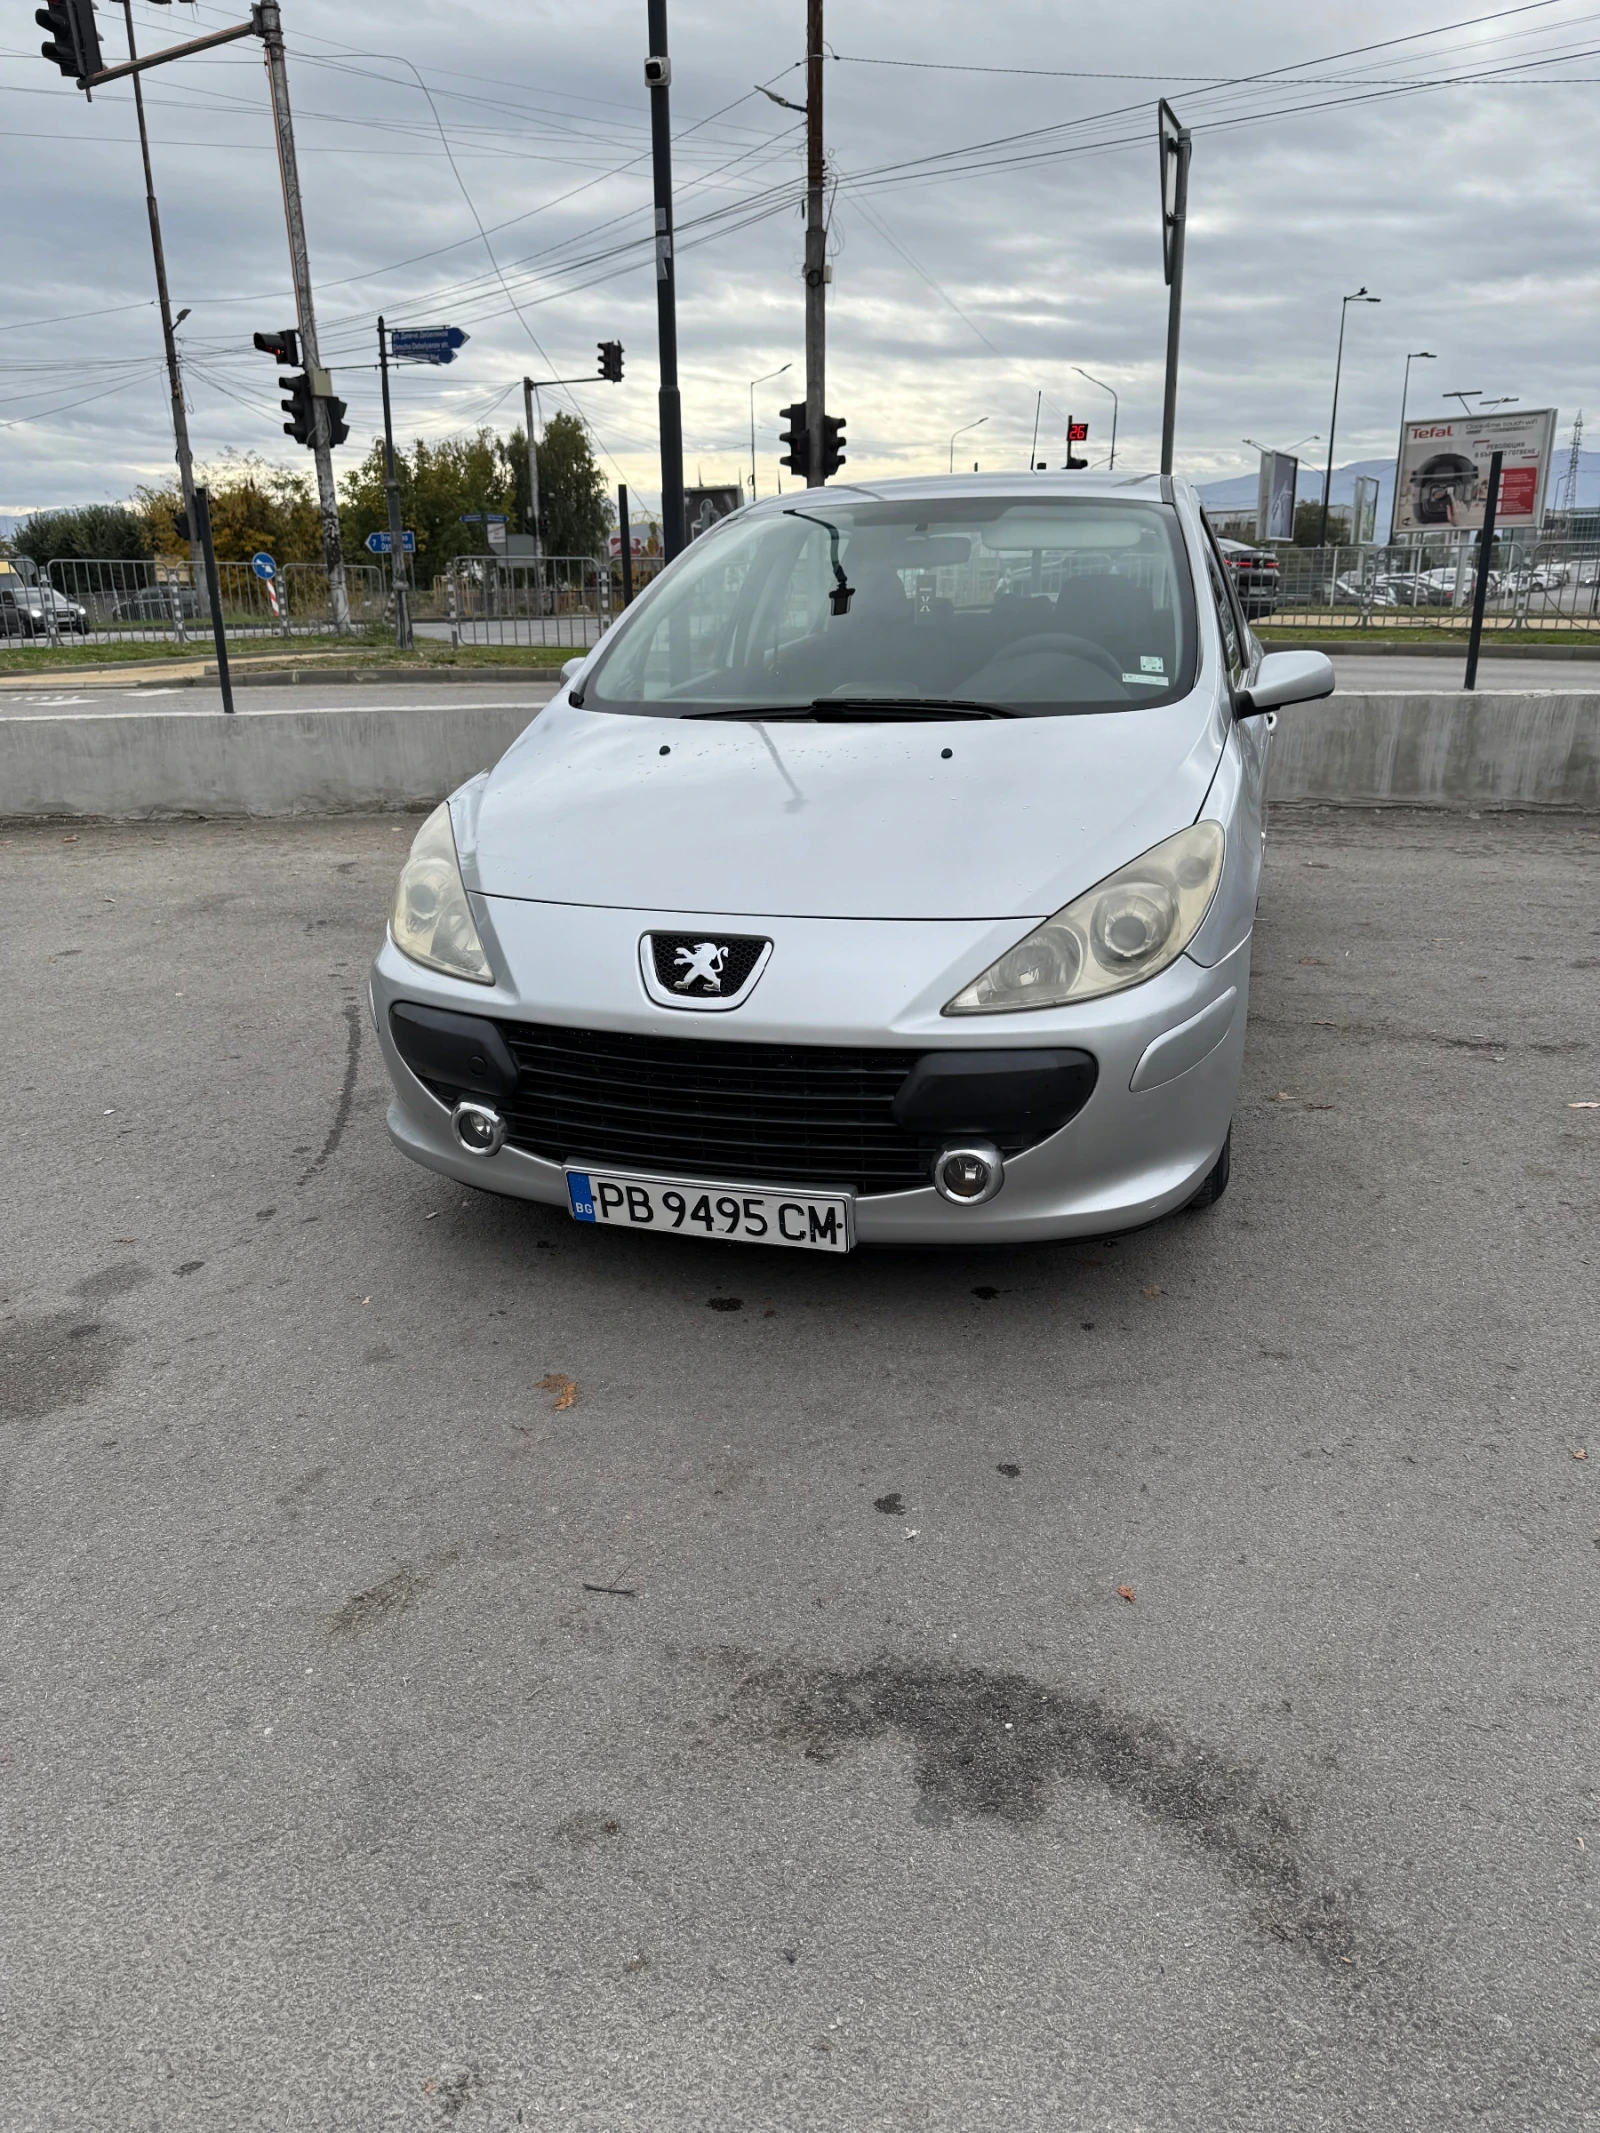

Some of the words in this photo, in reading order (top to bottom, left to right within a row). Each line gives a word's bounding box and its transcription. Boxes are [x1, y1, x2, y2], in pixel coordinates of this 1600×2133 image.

[1069, 425, 1085, 439] 26
[1411, 425, 1454, 440] Tefal
[1486, 442, 1525, 450] РЕВОЛЮЦИЯ
[575, 1201, 593, 1215] BG
[597, 1182, 654, 1223] PB
[661, 1191, 768, 1237] 9495
[778, 1202, 838, 1245] CM
